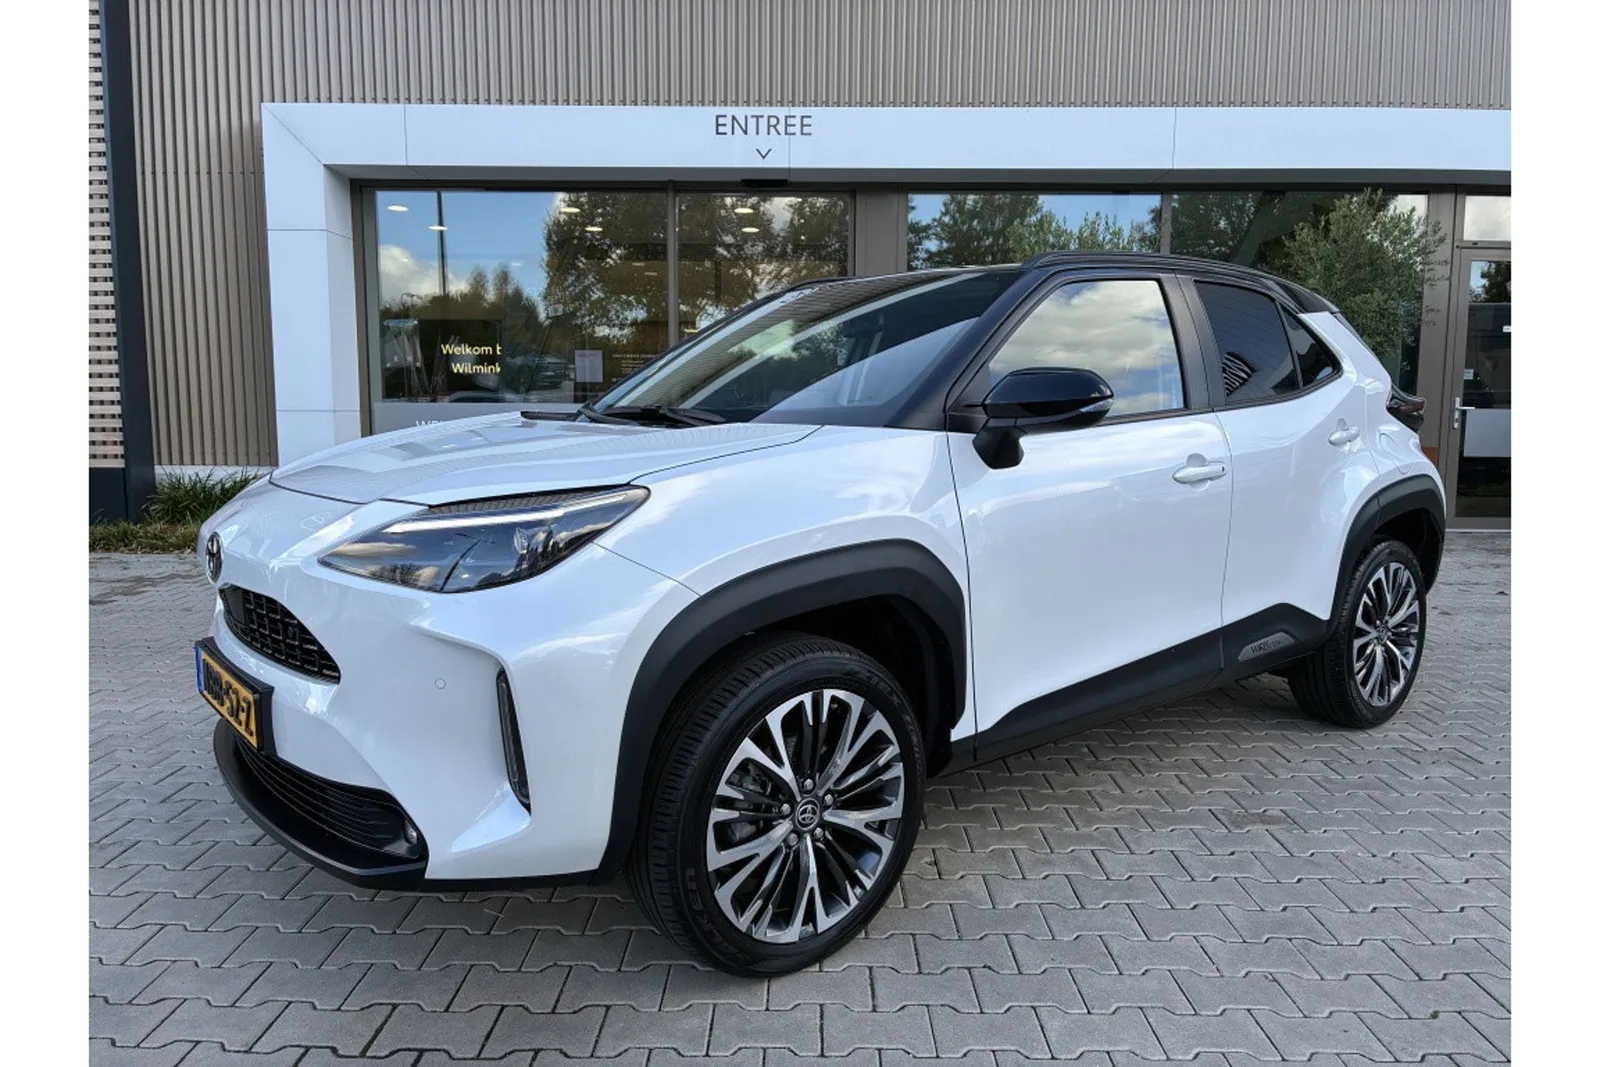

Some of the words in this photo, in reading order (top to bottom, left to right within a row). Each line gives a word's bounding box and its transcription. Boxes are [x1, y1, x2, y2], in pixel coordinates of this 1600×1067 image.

[715, 114, 813, 136] ENTREE
[441, 343, 493, 355] Welkom
[451, 362, 501, 374] Wilmink
